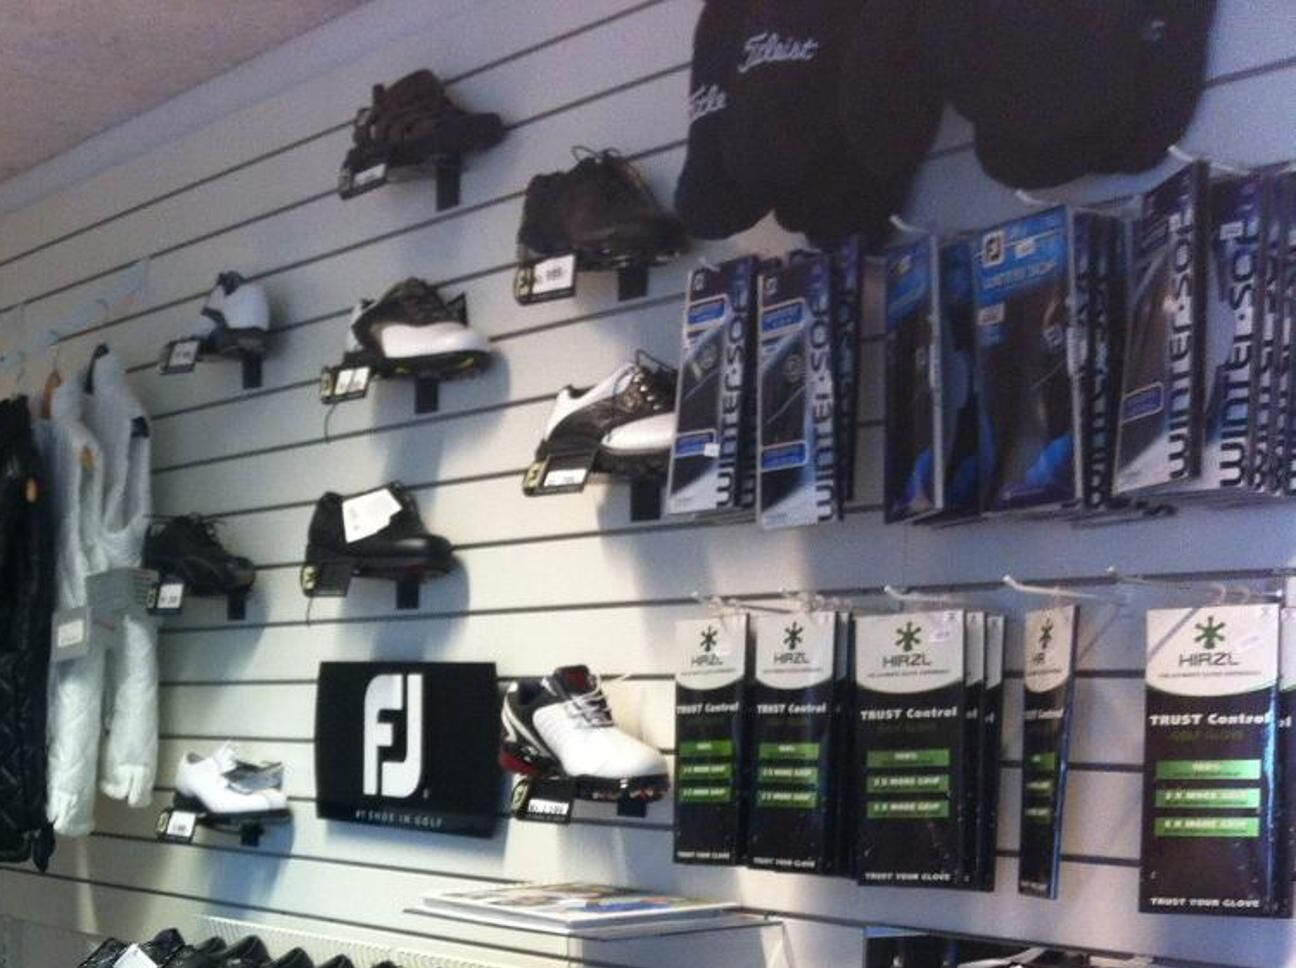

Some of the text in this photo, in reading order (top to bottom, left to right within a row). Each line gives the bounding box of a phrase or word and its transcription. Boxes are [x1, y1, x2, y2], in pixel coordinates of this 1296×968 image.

[882, 653, 932, 668] HIRZL
[1179, 652, 1240, 667] HIRZL
[860, 708, 902, 720] TRUST
[906, 706, 958, 719] Control
[1149, 713, 1203, 726] TRUST
[1207, 711, 1271, 725] Control
[363, 673, 424, 798] FJ
[1150, 897, 1186, 906] TRUST
[1222, 899, 1260, 908] GLOVE
